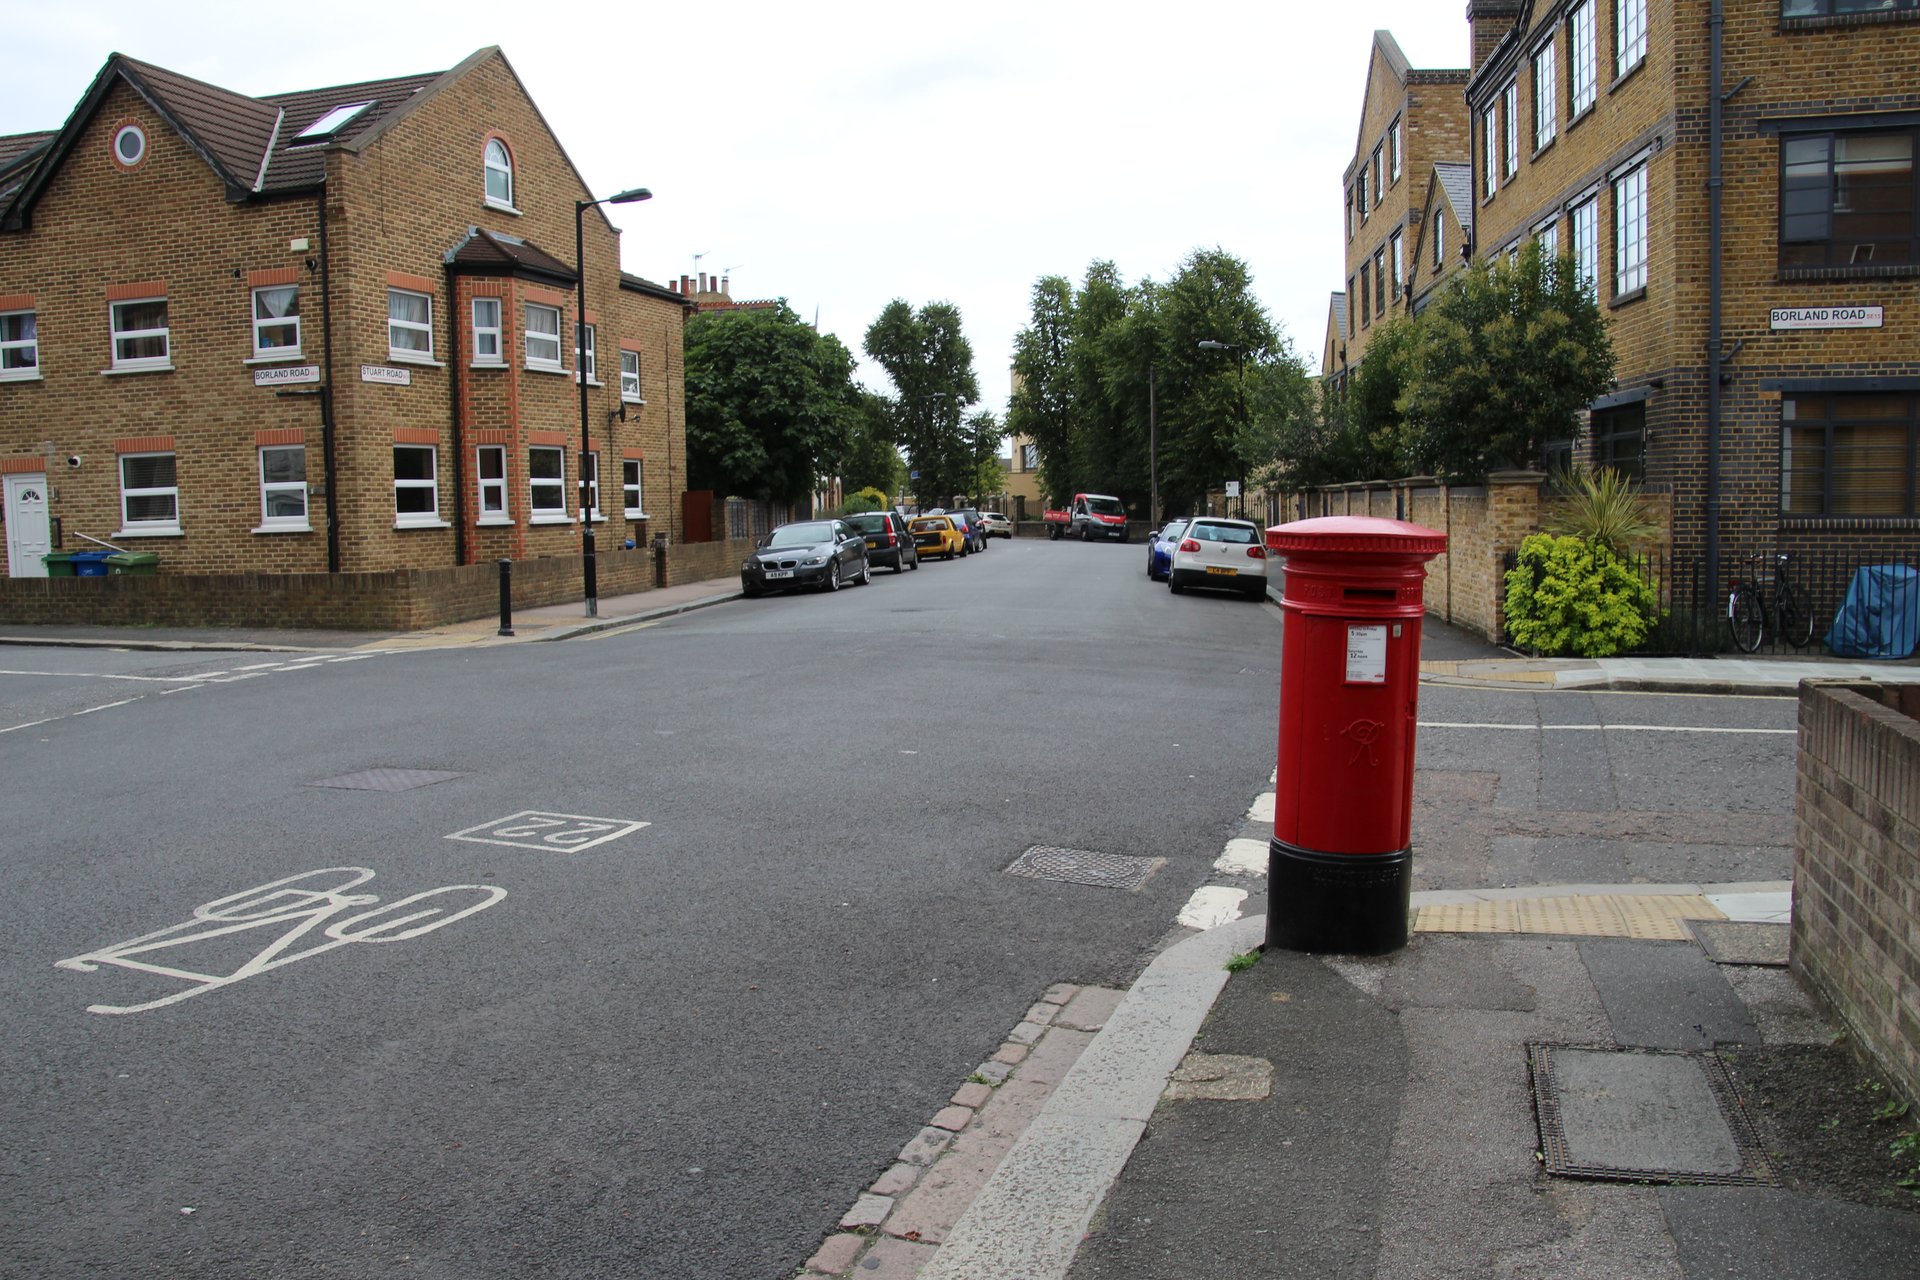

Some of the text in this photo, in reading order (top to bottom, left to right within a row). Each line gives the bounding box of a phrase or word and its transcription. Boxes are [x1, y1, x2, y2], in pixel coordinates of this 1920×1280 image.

[1772, 310, 1829, 321] BORLAND
[1832, 309, 1866, 320] ROAD
[255, 369, 289, 380] BORLAND
[289, 368, 310, 377] ROAD
[362, 366, 385, 377] STUART
[386, 369, 403, 379] ROAD
